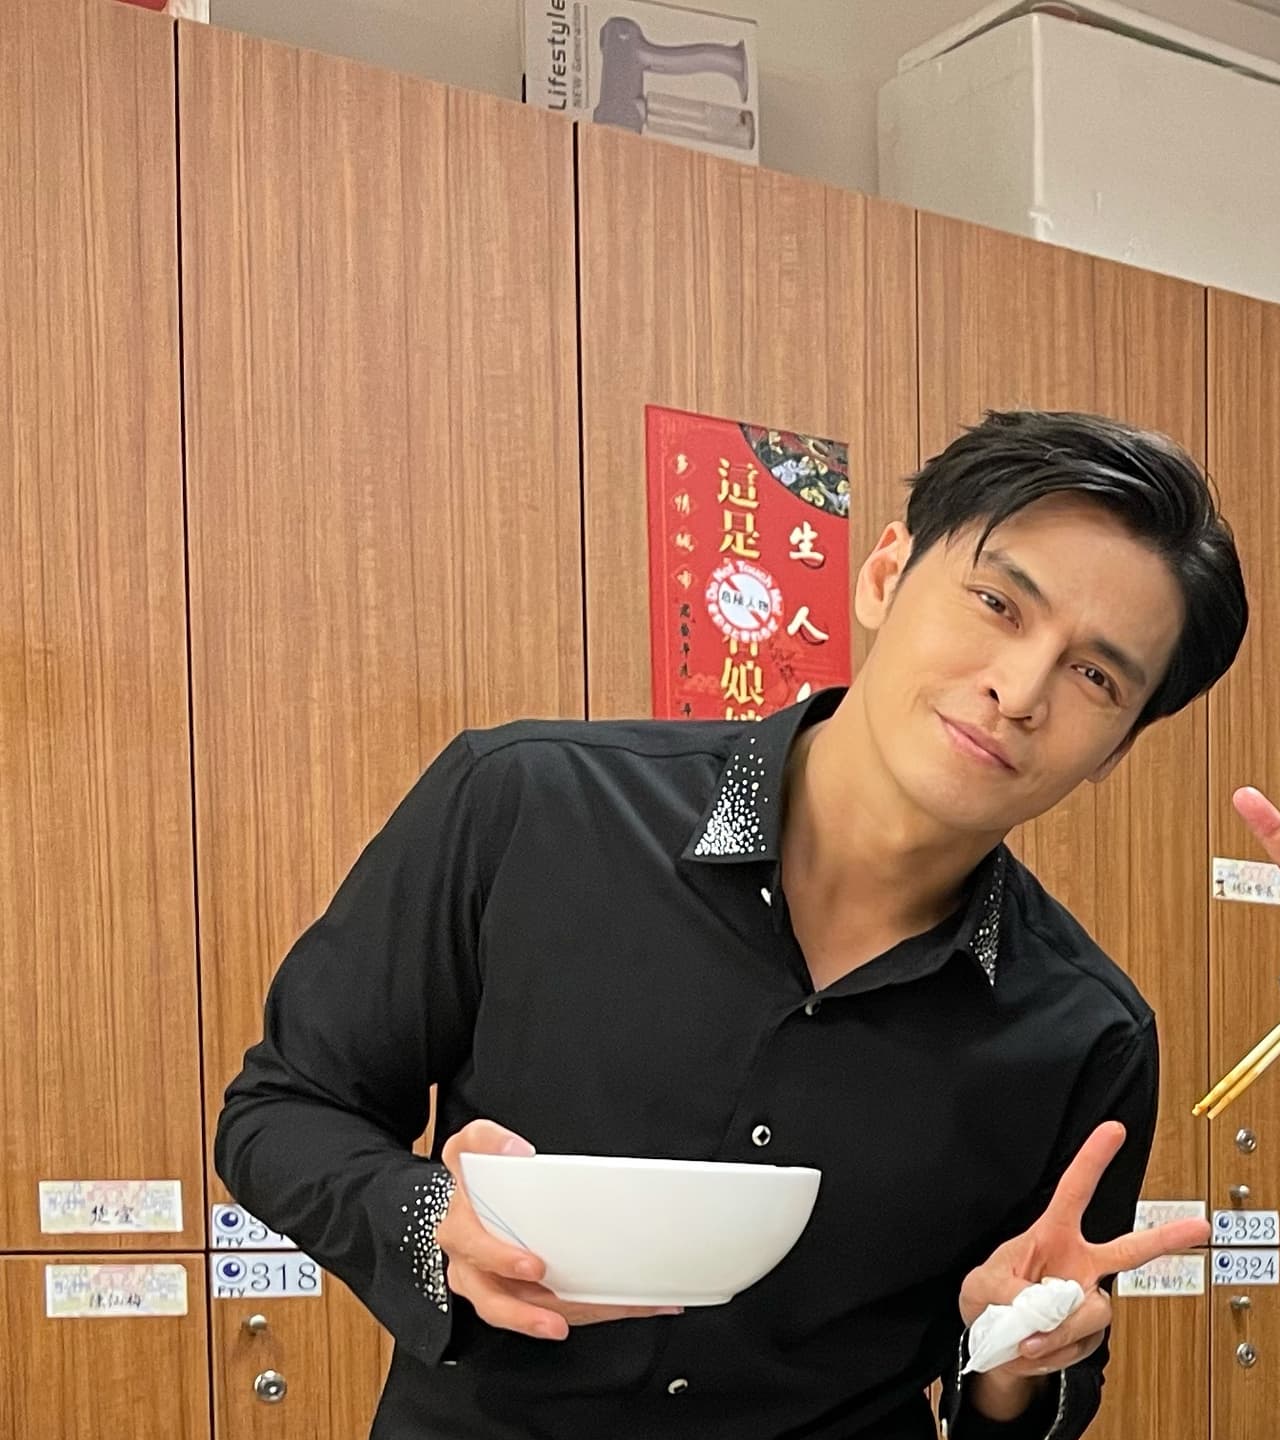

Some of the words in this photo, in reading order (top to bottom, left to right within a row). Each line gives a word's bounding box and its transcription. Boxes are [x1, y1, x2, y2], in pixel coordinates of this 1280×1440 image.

[546, 0, 570, 110] Lifestyle
[1235, 1216, 1276, 1240] 323
[216, 1236, 244, 1248] FTV
[251, 1262, 317, 1292] 318
[1235, 1256, 1276, 1280] 324
[218, 1285, 245, 1298] FTV
